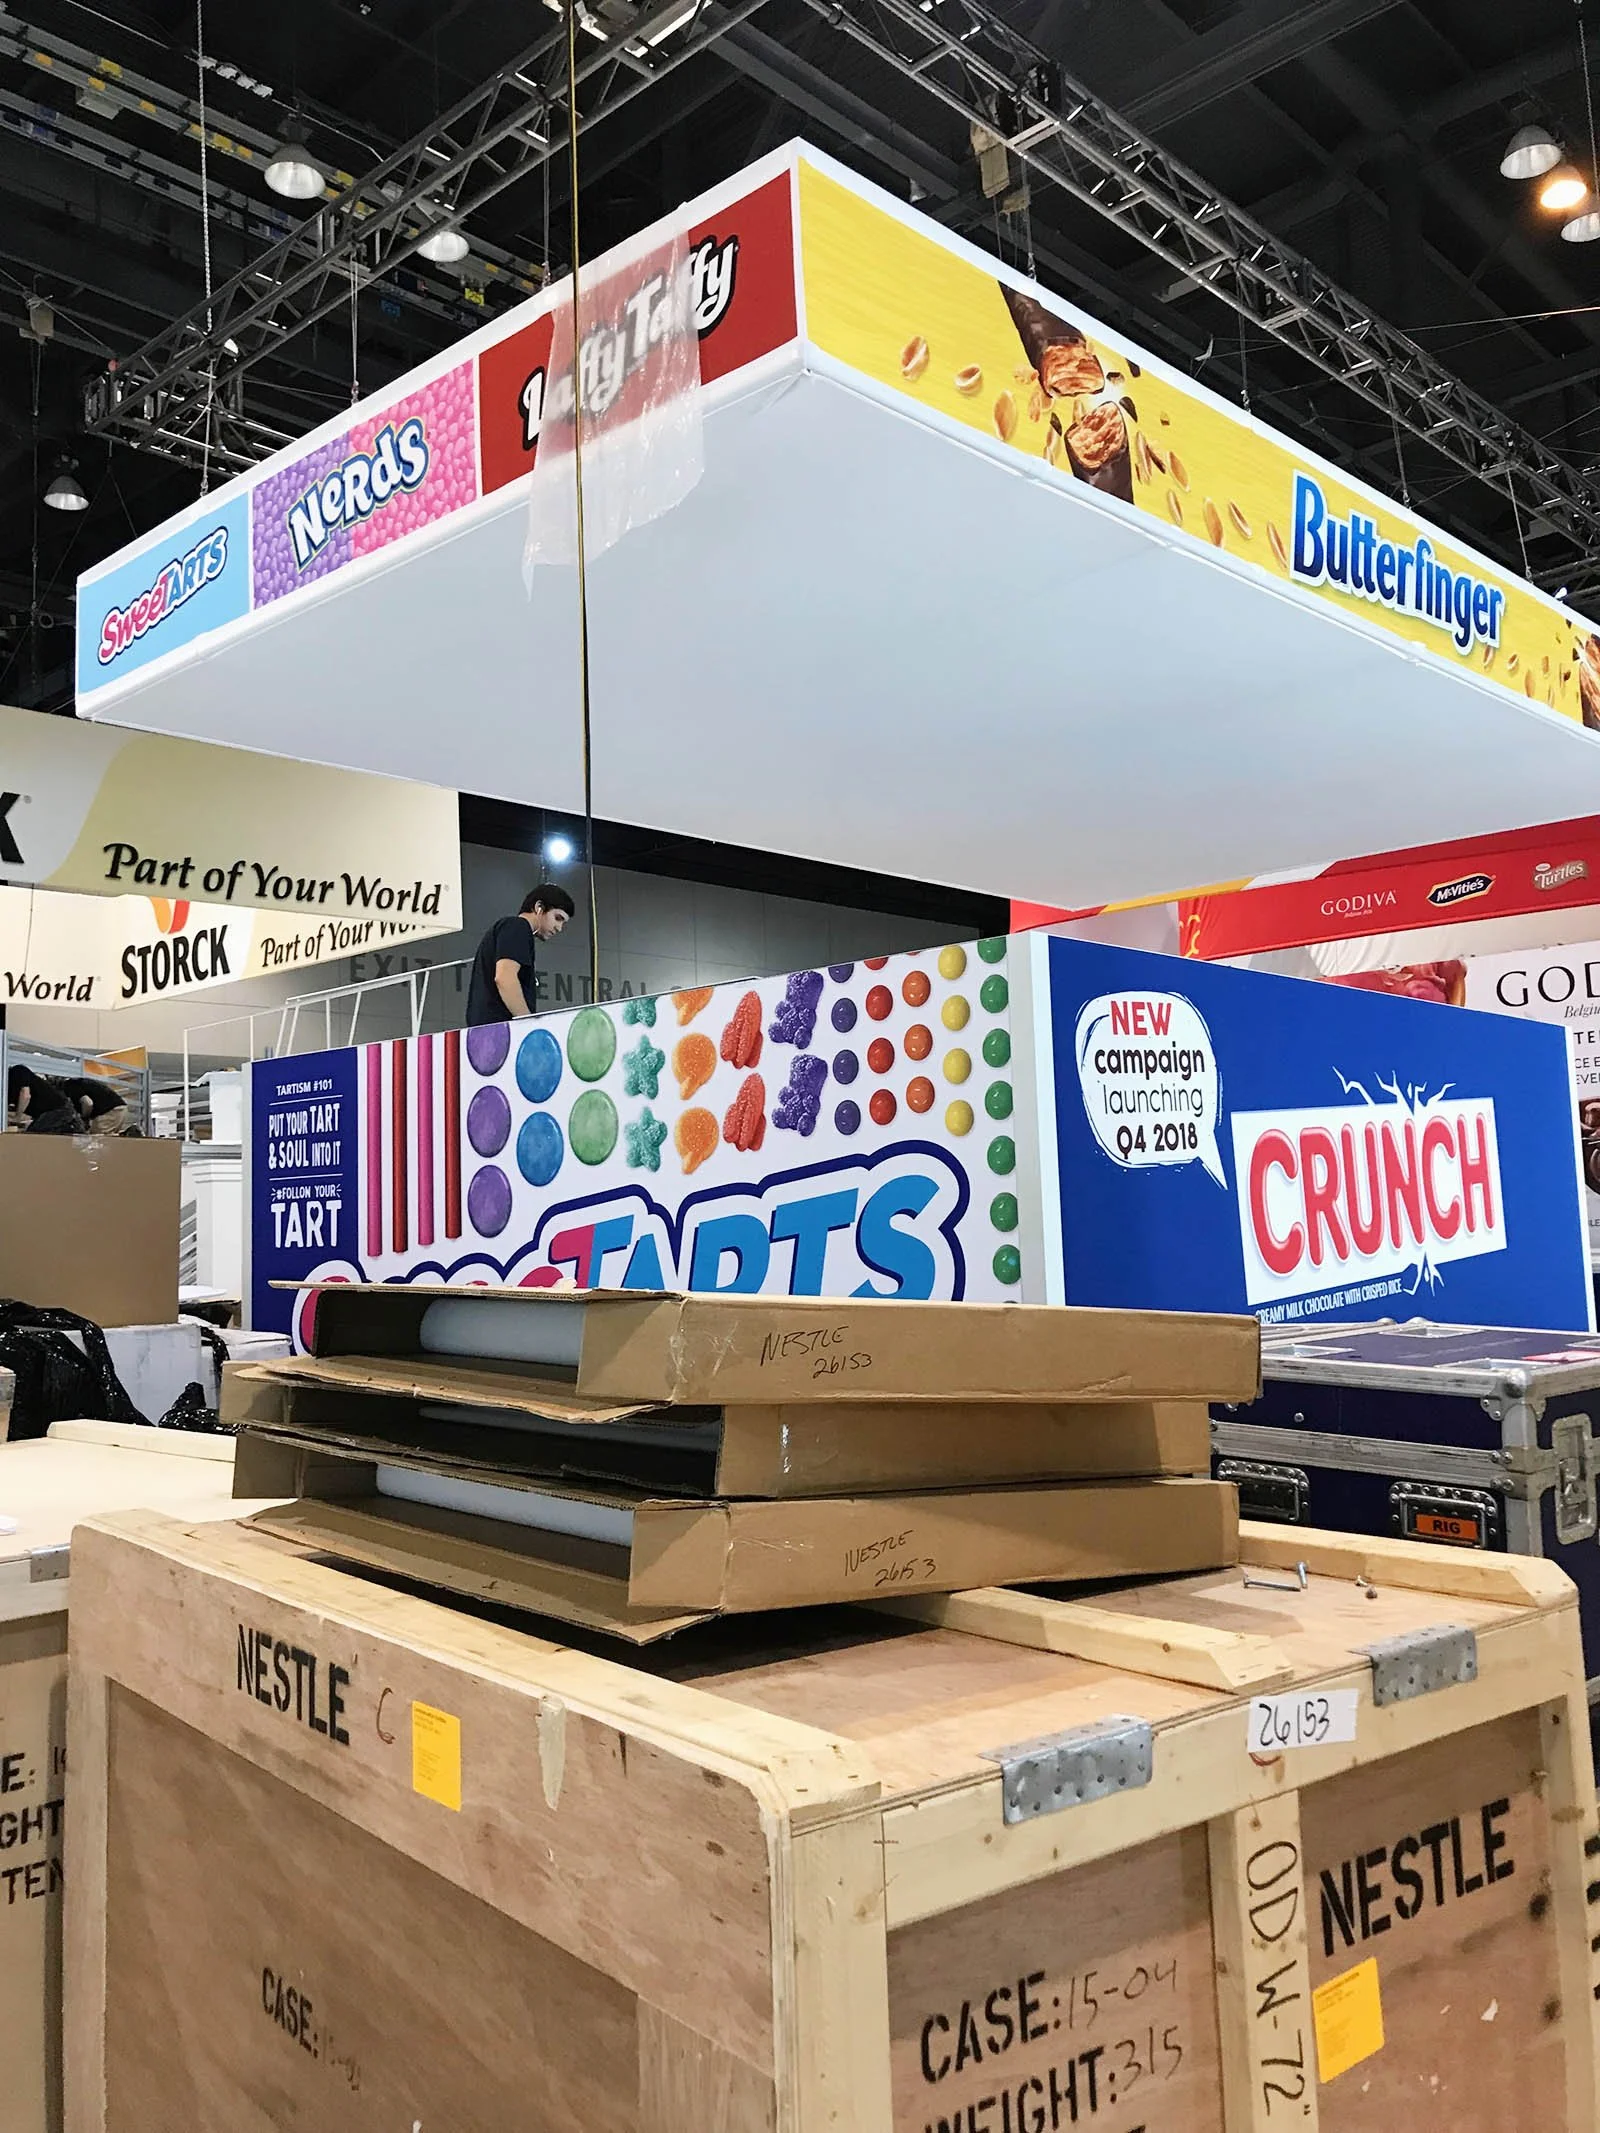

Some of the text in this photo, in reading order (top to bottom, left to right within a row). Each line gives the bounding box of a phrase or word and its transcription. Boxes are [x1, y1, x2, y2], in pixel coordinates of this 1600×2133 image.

[1292, 472, 1505, 652] Butterfinger
[103, 842, 442, 916] Part of Your World
[1534, 863, 1585, 889] Turtles
[1320, 890, 1397, 917] GODIVA
[121, 924, 231, 999] STORCK
[261, 933, 301, 967] Part
[304, 923, 325, 960] of
[328, 920, 374, 951] Your
[4, 970, 95, 1002] World
[1110, 1000, 1172, 1036] NEW
[1094, 1040, 1205, 1081] campaign
[276, 1078, 333, 1096] TARTISM #101
[1103, 1083, 1204, 1118] launching
[268, 1102, 340, 1139] PUT YOUR TART
[1116, 1121, 1198, 1160] Q4 2018
[268, 1139, 341, 1170] & SOUL INTO IT
[314, 1184, 336, 1198] YOUR
[1247, 1112, 1495, 1277] CRUNCH
[270, 1199, 343, 1249] TART
[1286, 1299, 1305, 1320] MILK
[1304, 1291, 1345, 1315] CHOCOLATE
[1344, 1286, 1362, 1305] WITH
[1361, 1281, 1388, 1301] CRISPED
[1387, 1278, 1402, 1296] RICE
[760, 1325, 849, 1367] NESTLE
[812, 1352, 872, 1379] 26153
[1432, 1518, 1461, 1535] RIG
[237, 1623, 350, 1746] NESTLE
[1258, 1699, 1331, 1748] 26153
[1319, 1798, 1516, 1957] NESTLE
[262, 1967, 318, 2059] CASE:
[921, 1970, 1061, 2084] CASE:
